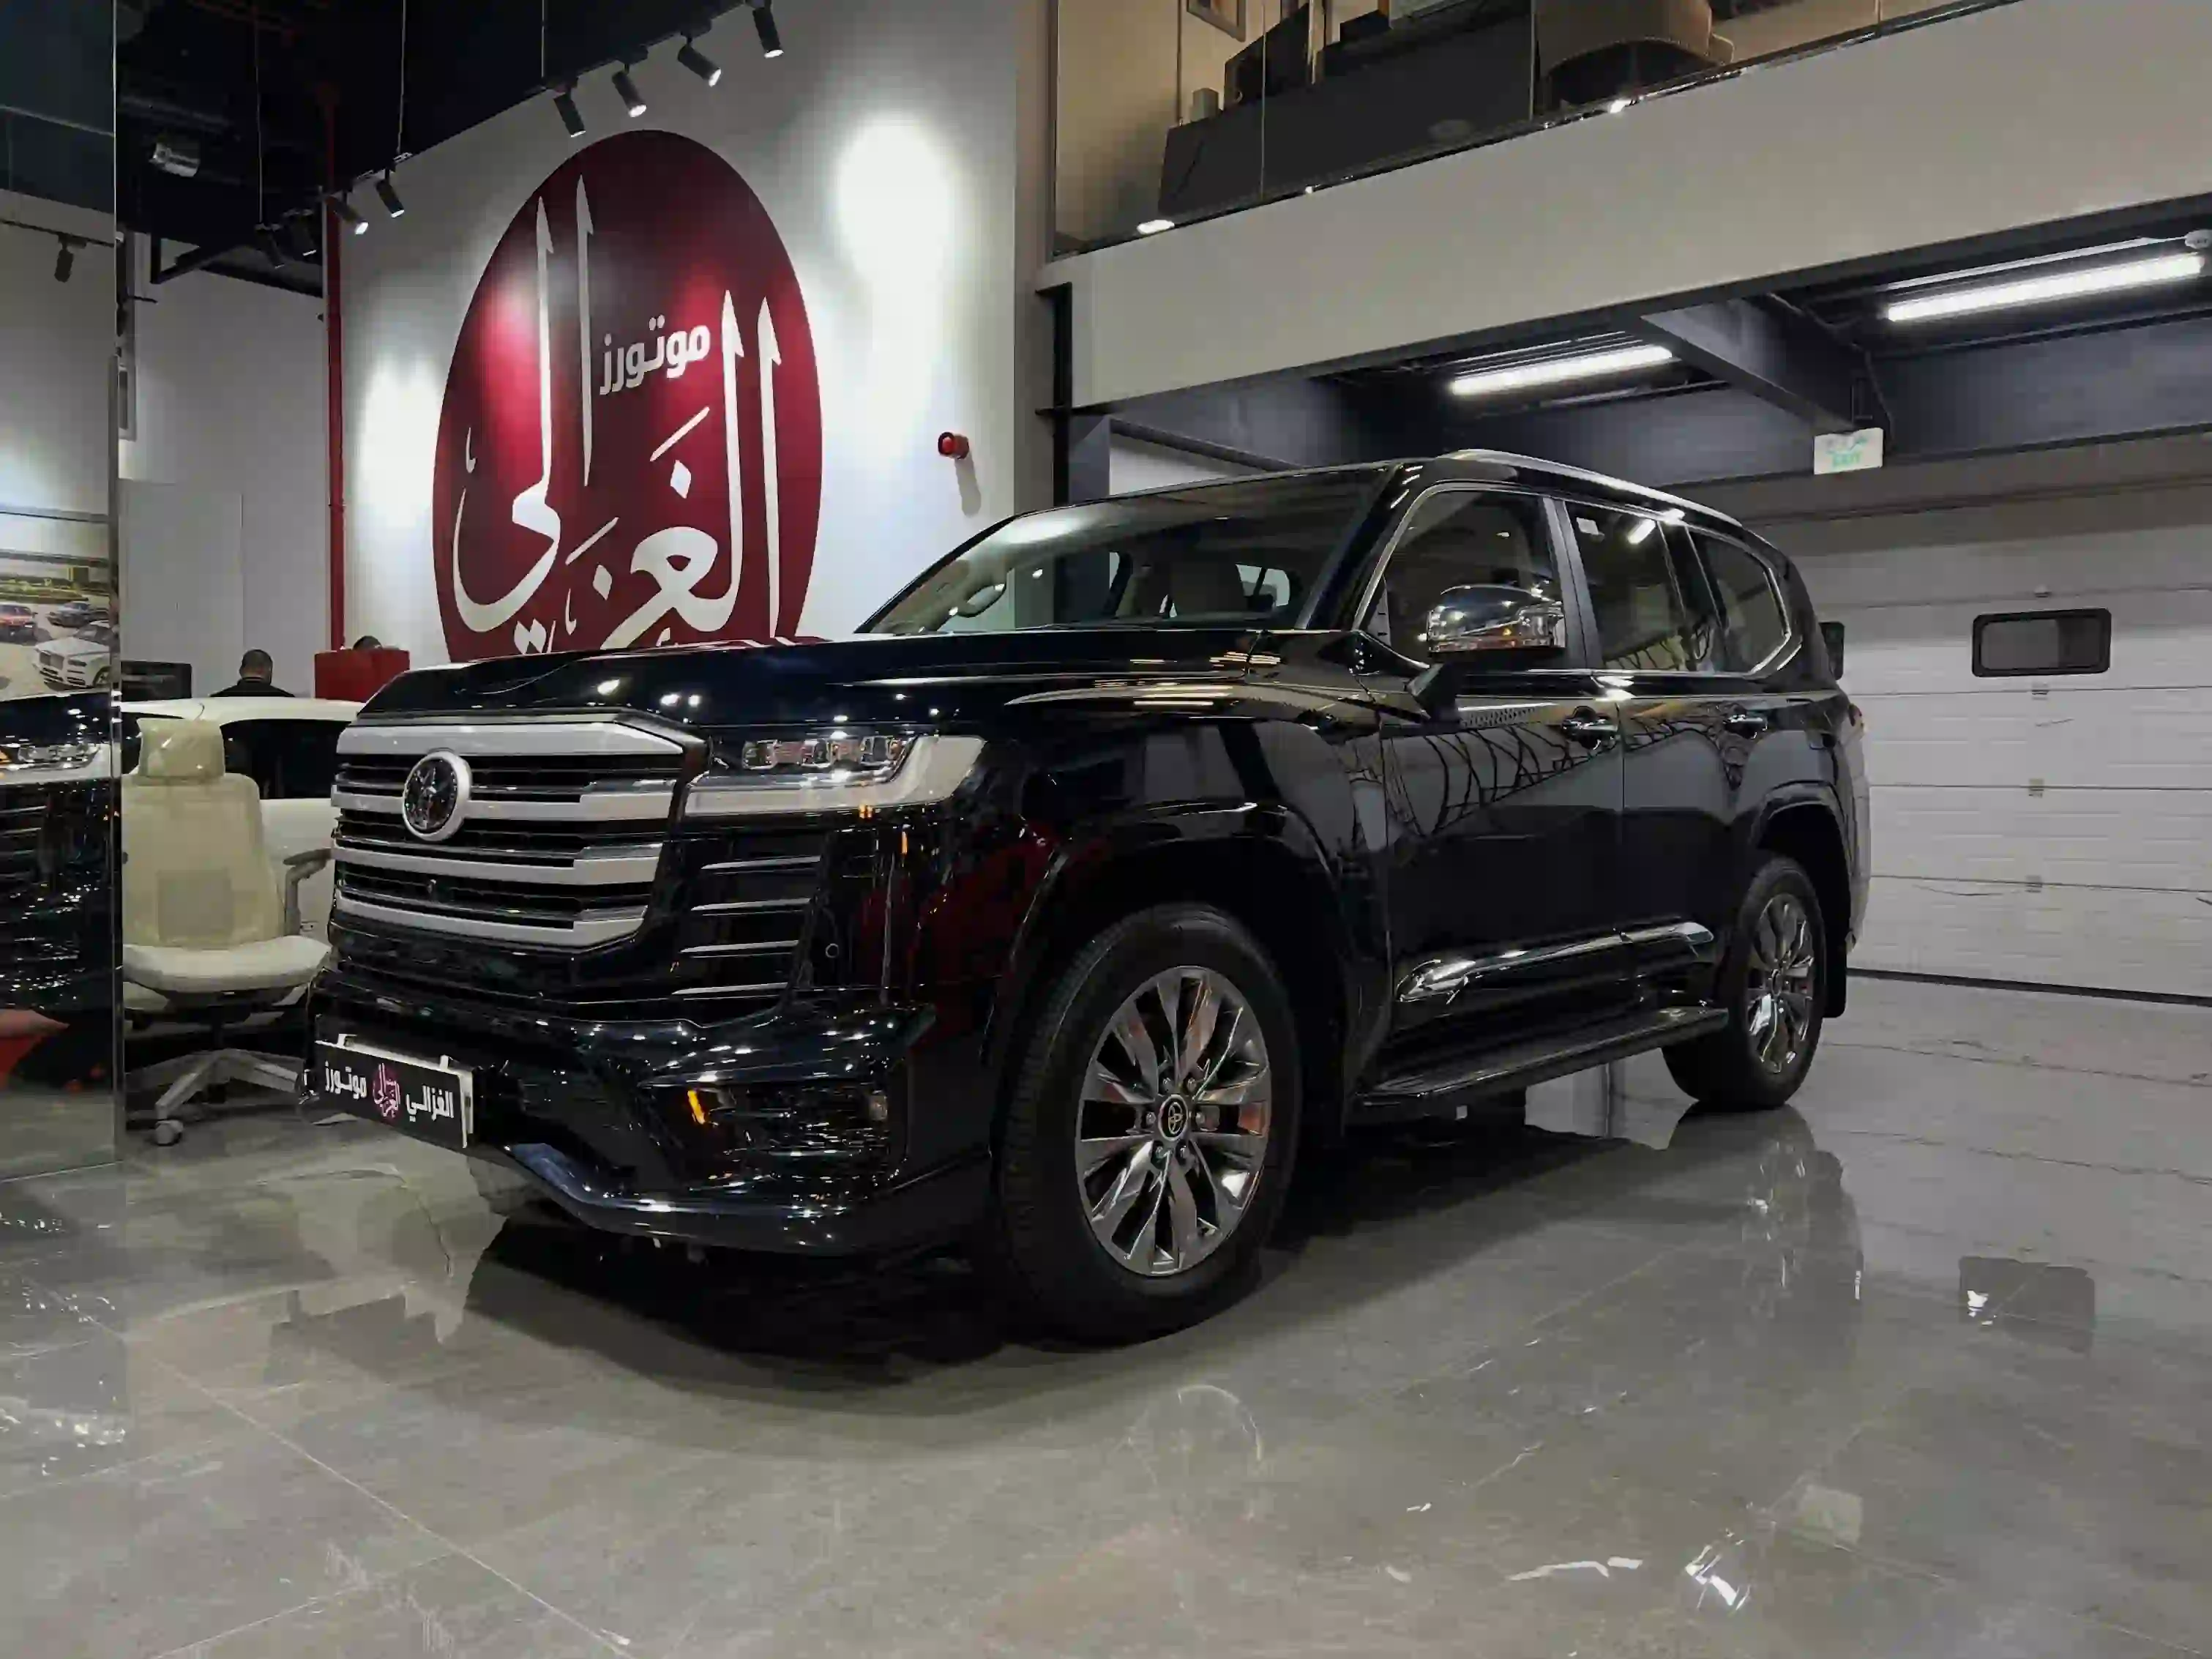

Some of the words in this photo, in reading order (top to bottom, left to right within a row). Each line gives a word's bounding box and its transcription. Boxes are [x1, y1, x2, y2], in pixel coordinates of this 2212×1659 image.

[599, 315, 711, 395] موتورز
[324, 1060, 367, 1100] موتورز
[406, 1084, 455, 1122] الغزالي
